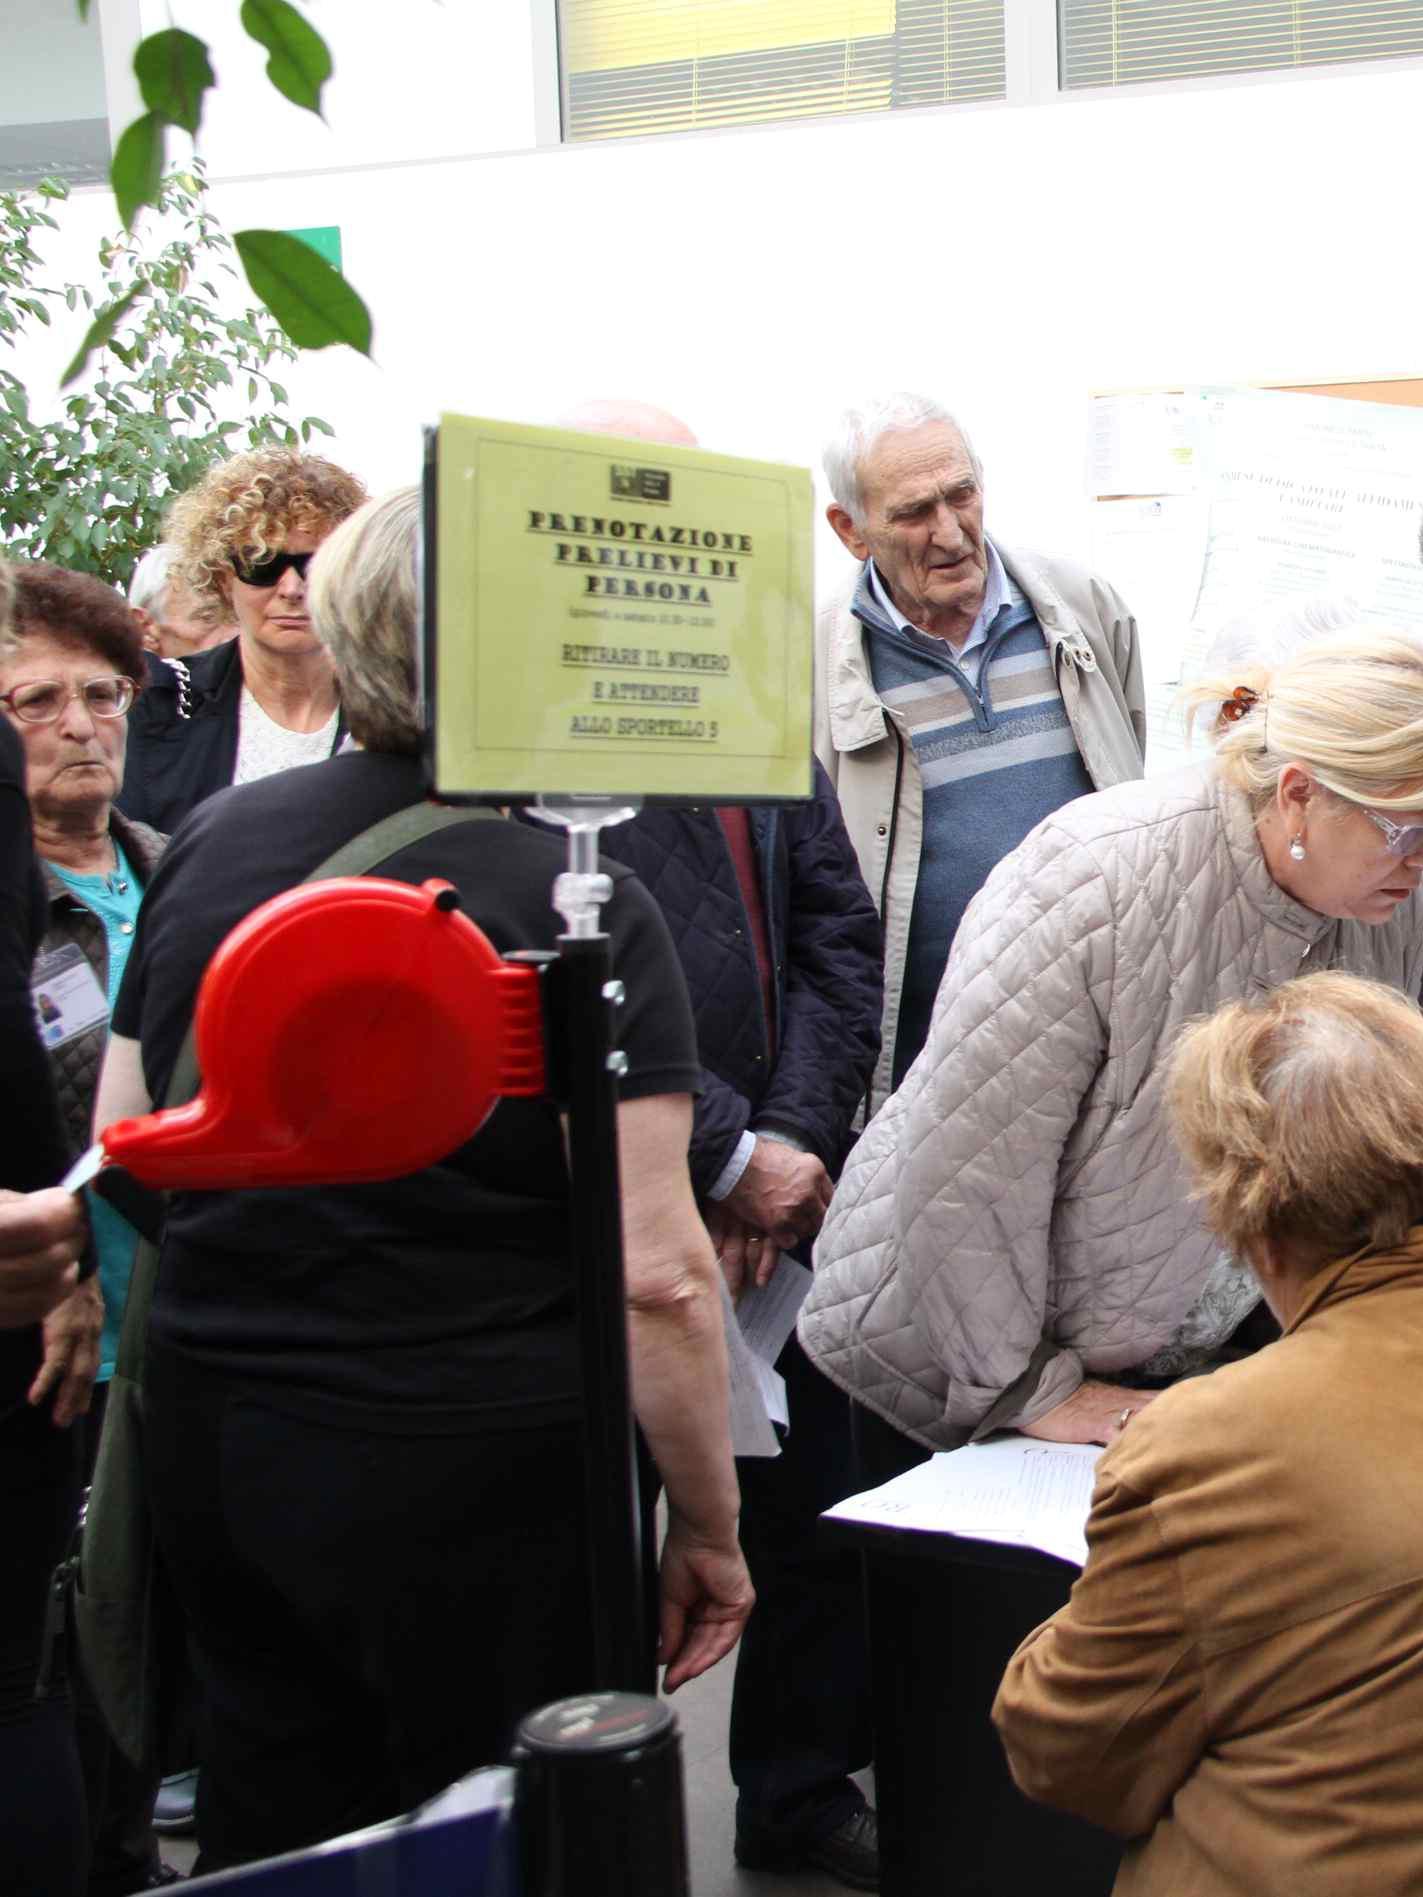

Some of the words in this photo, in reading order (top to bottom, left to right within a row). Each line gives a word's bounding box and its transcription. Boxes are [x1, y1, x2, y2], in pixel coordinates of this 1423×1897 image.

[528, 510, 753, 552] PRENOTAZIONE
[556, 543, 700, 575] PRELIEVI
[709, 559, 739, 578] DI
[586, 575, 712, 604] PERSONA
[561, 644, 641, 666] RITIRARE
[646, 650, 662, 667] IL
[668, 651, 730, 672] NUMERO
[593, 681, 603, 699] E
[608, 683, 700, 703] ATTENDERE
[570, 715, 612, 734] ALLO
[616, 717, 705, 738] SPORTELLO
[709, 721, 719, 739] 5
